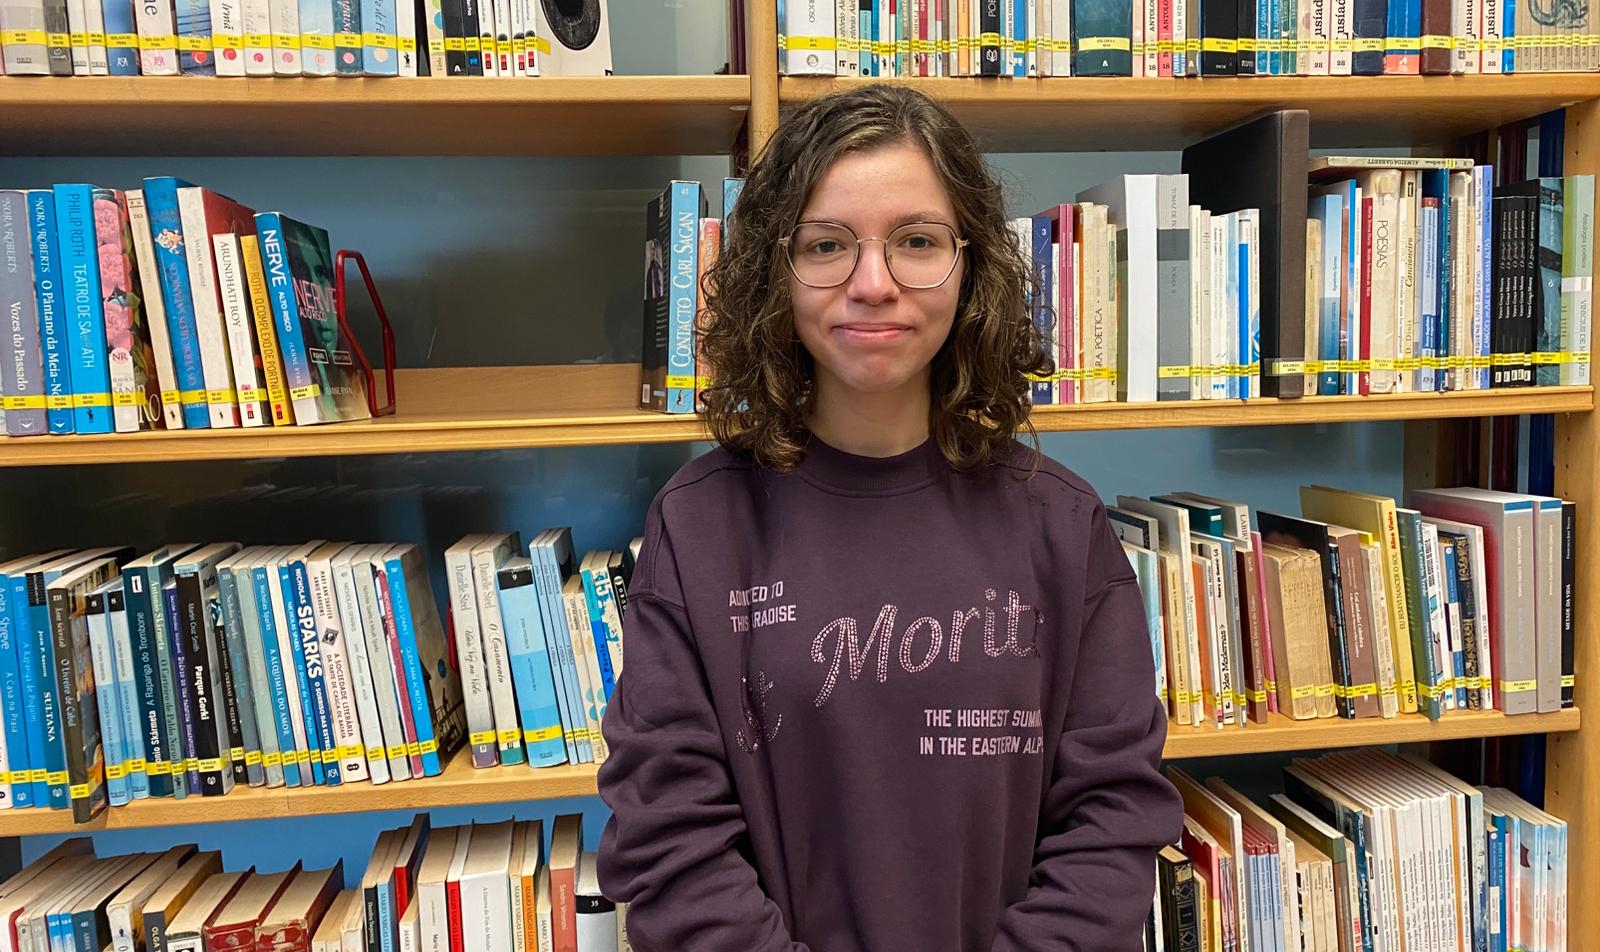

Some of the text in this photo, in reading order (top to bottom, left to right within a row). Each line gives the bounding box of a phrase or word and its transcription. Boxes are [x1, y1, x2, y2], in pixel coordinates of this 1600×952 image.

[35, 197, 50, 273] NORA ROBERTS
[67, 194, 84, 257] PHILIP ROTH
[1041, 228, 1047, 236] 3
[1376, 220, 1389, 269] POESIAS
[1580, 213, 1589, 269] Antologia poética
[4, 228, 17, 273] ROBERTS
[1404, 237, 1415, 288] Cancioneiro
[73, 263, 90, 303] TEATRO
[220, 241, 237, 304] ARUNDHATI
[262, 229, 292, 333] NERVE ALTO RISCO
[672, 211, 694, 368] CONTACTO CARL SAGAN
[43, 291, 56, 336] Pântano
[78, 304, 91, 319] DE
[292, 276, 338, 314] NERVE
[10, 302, 22, 333] Vozes
[227, 305, 241, 328] ROY
[1578, 299, 1588, 333] VINICIUS
[256, 306, 273, 349] COMPLEXO
[266, 360, 279, 391] PORTN
[288, 341, 302, 385] JEANNE RYAN
[1577, 345, 1586, 377] MAES
[14, 349, 28, 390] Passado
[1387, 511, 1398, 550] Alice Vieira
[1415, 519, 1424, 543] Poesia
[1417, 552, 1426, 577] Cesário
[455, 565, 471, 611] Danielle Steel
[479, 562, 495, 609] Danielle Steel
[772, 580, 784, 599] TO
[1394, 572, 1403, 599] NASCER
[1420, 578, 1428, 597] Verde
[0, 588, 11, 650] Anita Shreve
[151, 580, 166, 651] Antonio Skármeta
[187, 602, 197, 621] Martin
[259, 584, 273, 631] Nicholas Sparks
[287, 600, 301, 652] NICHOLAS SPARKS
[295, 568, 323, 679] NICHOLAS SPARKS
[383, 591, 396, 639] NICHOLAS SPARKS
[392, 581, 410, 637] NICHOLAS SPARKS
[730, 604, 797, 633] THIS RADISE
[137, 612, 147, 650] Trombone
[191, 635, 200, 652] Smith
[810, 588, 1043, 707] Morit
[23, 650, 34, 683] Rapariga
[489, 623, 506, 685] O Casamento
[1219, 630, 1229, 672] Modernas
[5, 679, 16, 699] Casa
[61, 667, 73, 695] Livreiro
[142, 662, 154, 699] Rapariga
[161, 666, 173, 703] Carteiro
[193, 665, 210, 720] Parque Gorki
[271, 655, 283, 696] ALQUIMIA
[278, 711, 290, 737] AMOR
[335, 659, 348, 701] SOCIEDADE
[405, 646, 415, 666] QUEM
[412, 681, 424, 713] ACREDITA
[9, 712, 20, 733] Praia
[27, 694, 37, 722] Pequim
[43, 691, 56, 743] SULTANA
[66, 706, 77, 727] Cabul
[164, 713, 177, 735] Pablo
[314, 688, 324, 713] SORRISO
[321, 728, 331, 751] ESTREL
[341, 701, 355, 739] LITERÁRIA
[923, 709, 1042, 728] THE HIGHEST SUMM
[168, 736, 180, 765] Nerud
[919, 736, 1043, 756] IN THE EASTERN ALP
[525, 885, 533, 906] MARIO
[558, 883, 566, 905] Sandro
[514, 906, 522, 930] VARGAS
[525, 906, 533, 930] VARGAS
[151, 926, 160, 949] OLGA
[404, 929, 412, 951] MARIO
